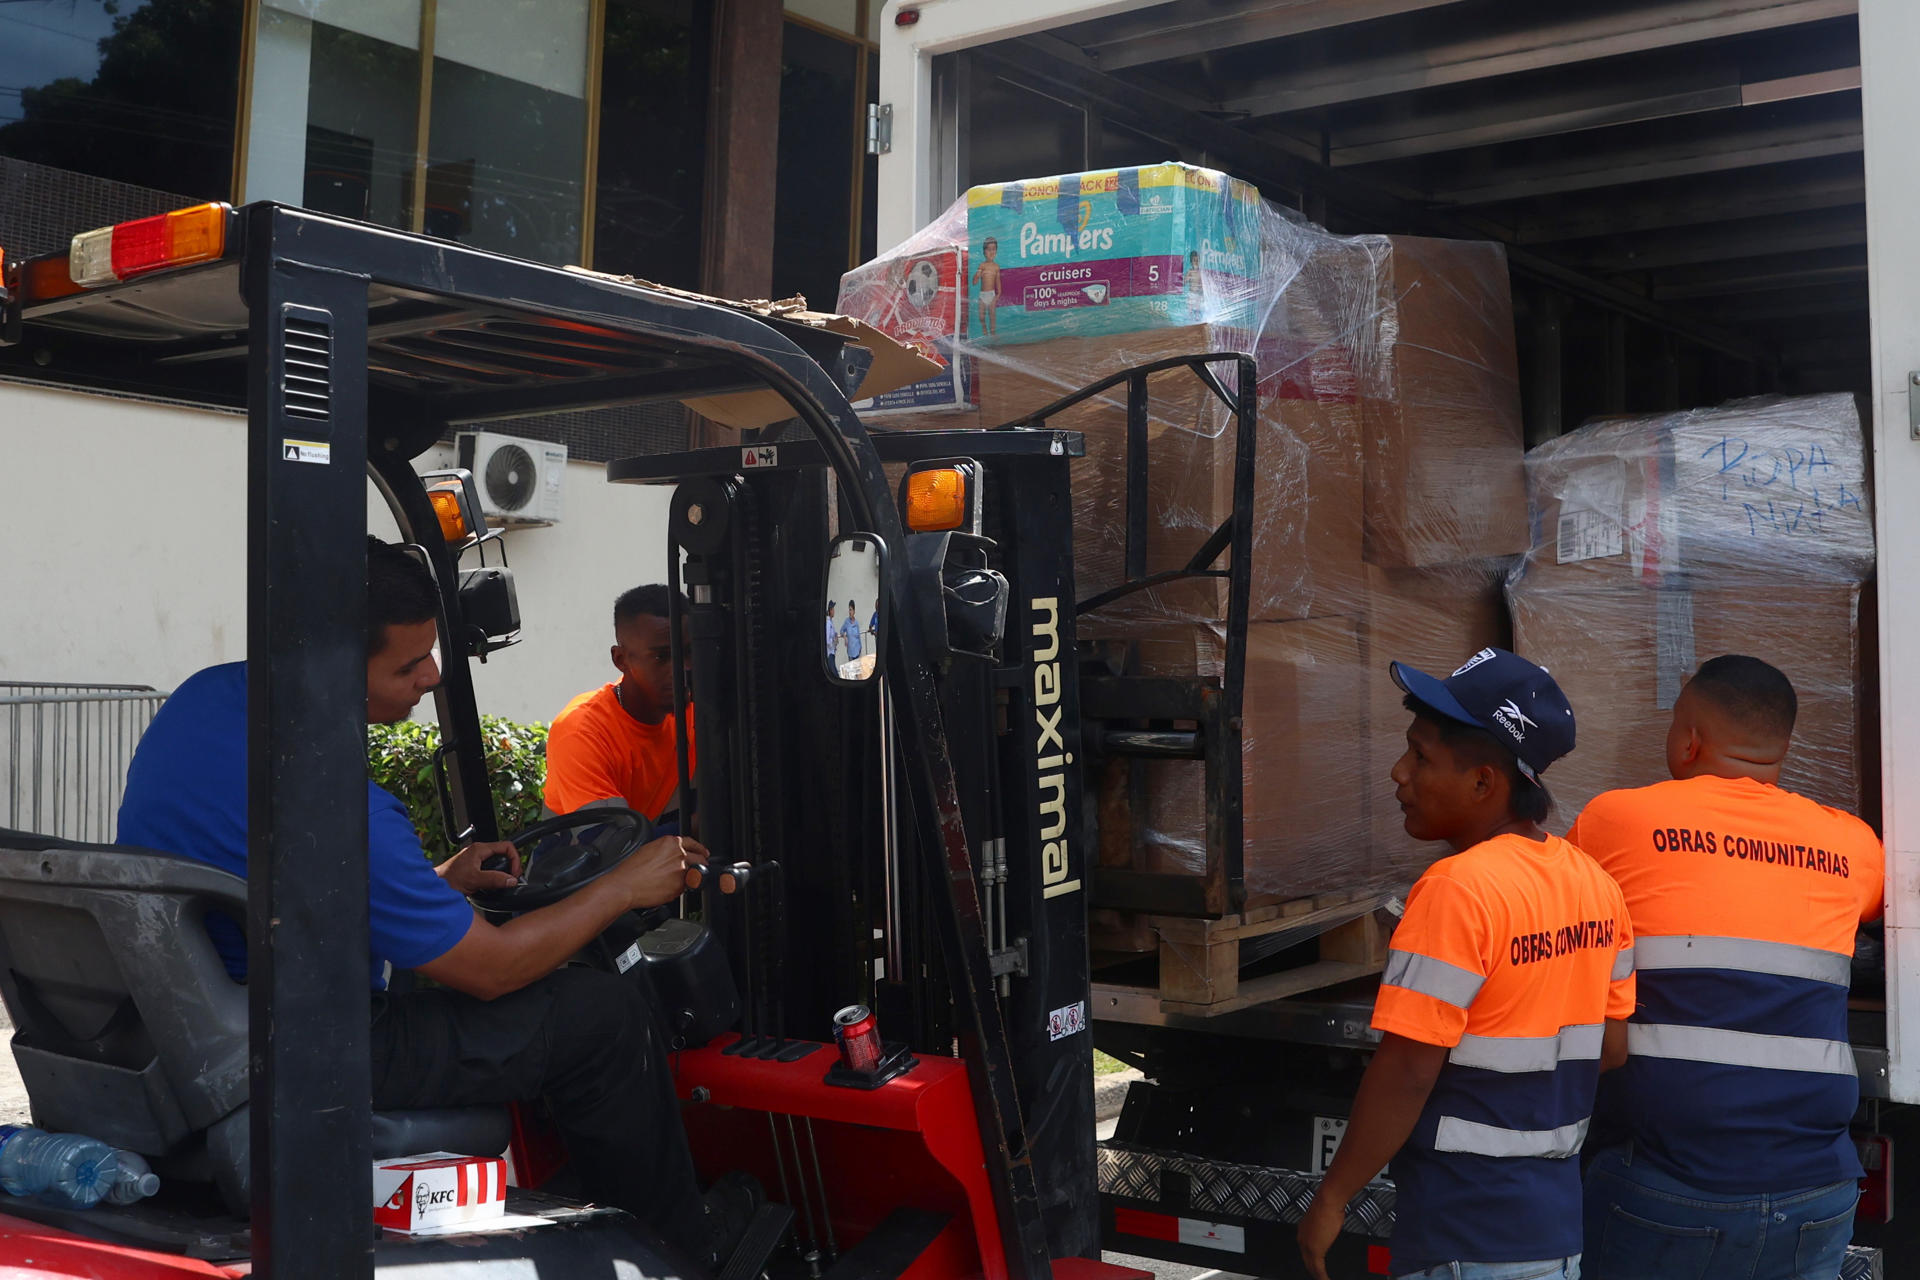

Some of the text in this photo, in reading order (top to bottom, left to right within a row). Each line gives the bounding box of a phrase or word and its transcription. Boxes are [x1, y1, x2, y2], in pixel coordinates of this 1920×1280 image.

[1040, 266, 1092, 282] cruisers
[1148, 265, 1159, 282] 5
[1033, 296, 1078, 308] days & nights
[1150, 300, 1168, 311] 128
[1492, 709, 1526, 744] Reebok
[1031, 597, 1081, 899] maximal
[1653, 828, 1849, 879] OBRAS COMUNITARIAS
[429, 1189, 455, 1204] KFC
